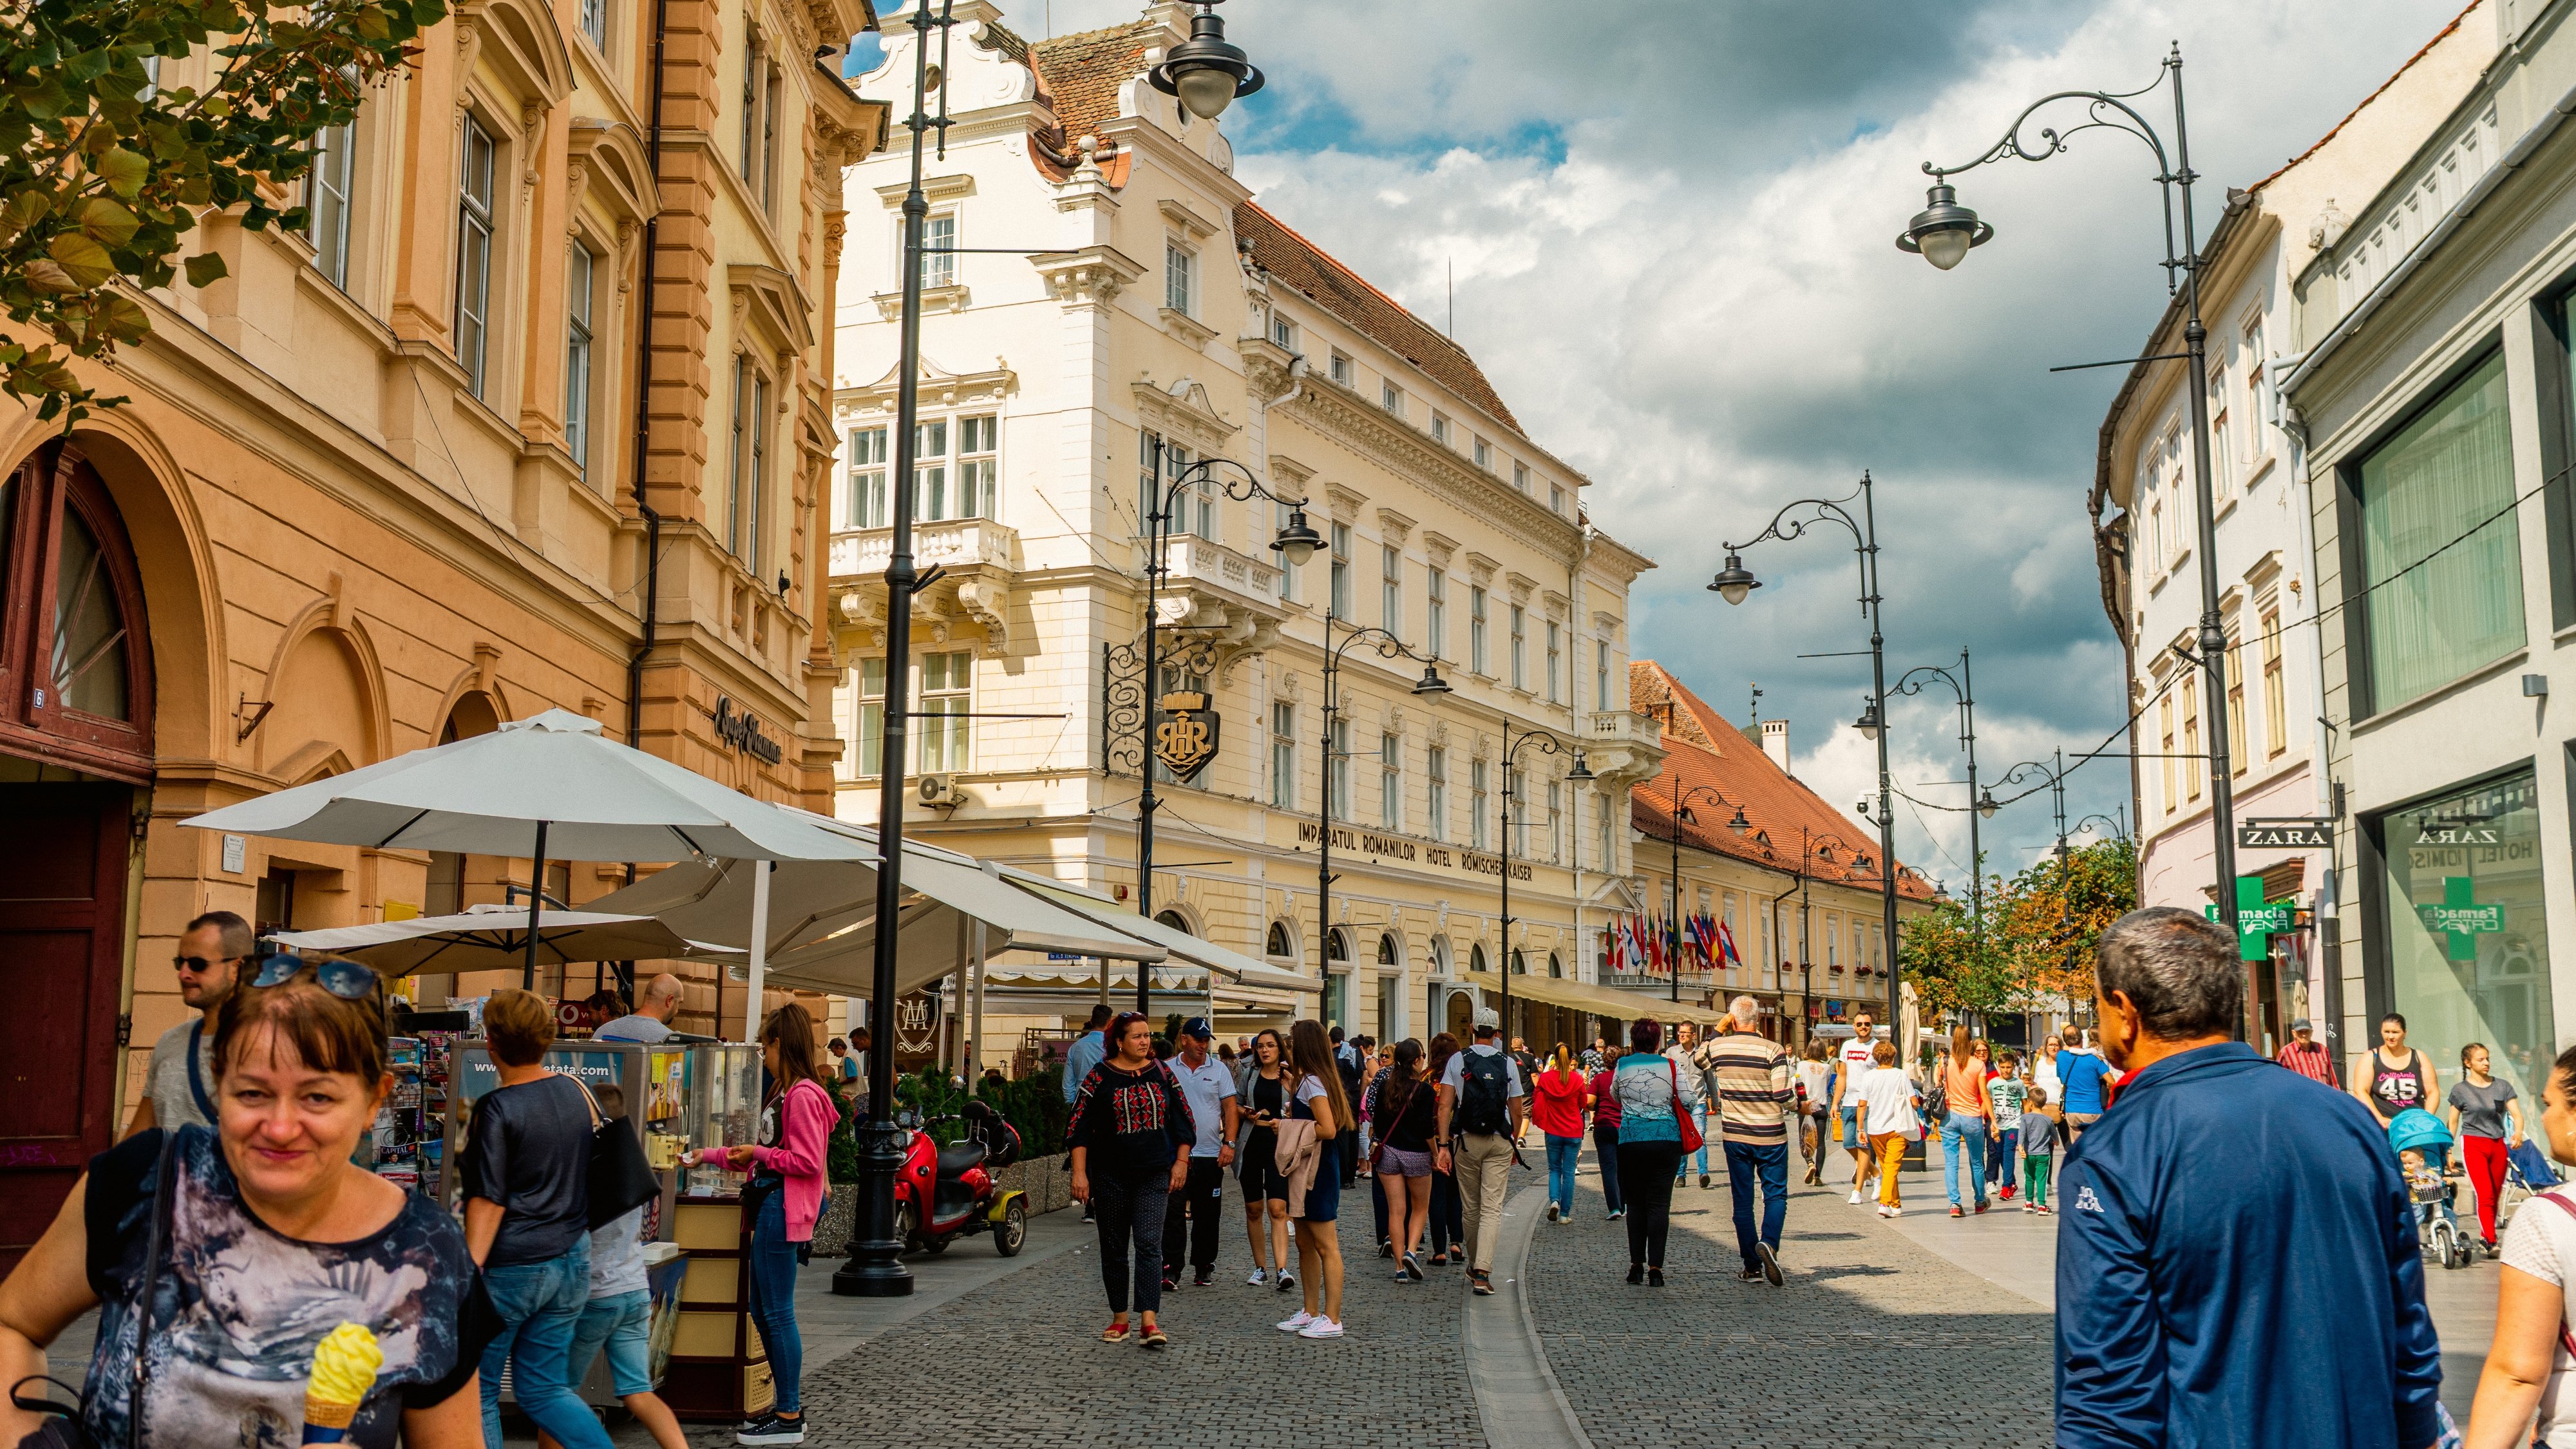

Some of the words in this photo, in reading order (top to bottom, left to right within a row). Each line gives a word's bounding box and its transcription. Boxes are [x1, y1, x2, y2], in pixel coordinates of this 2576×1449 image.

[37, 691, 43, 706] 6
[2246, 831, 2327, 845] ZARA
[1363, 835, 1416, 862] ROMANILOR
[1426, 848, 1452, 867] HOTEL
[1508, 862, 1532, 882] KAISER
[2213, 907, 2287, 919] Fmacia
[2380, 1077, 2418, 1100] 45
